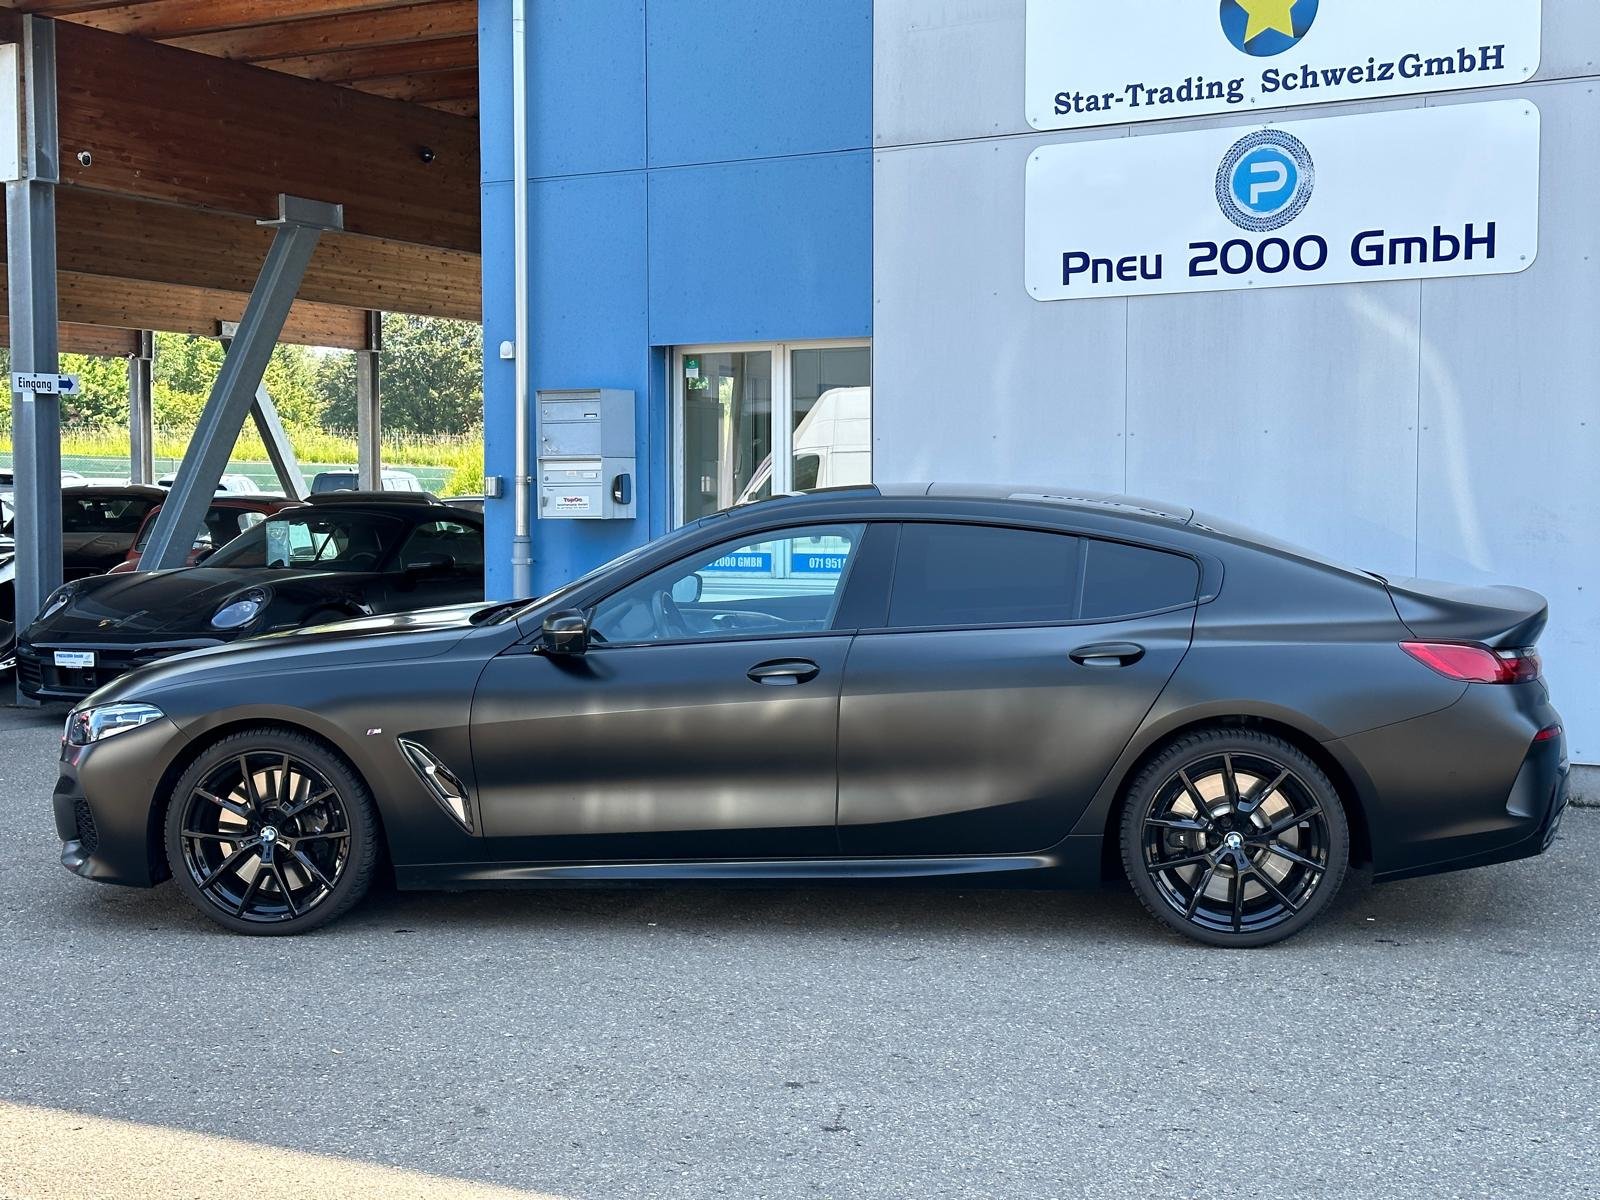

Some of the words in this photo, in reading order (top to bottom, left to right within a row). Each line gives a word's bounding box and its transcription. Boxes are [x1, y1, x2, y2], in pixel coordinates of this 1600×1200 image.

[1053, 75, 1245, 115] Star-Trading
[1061, 249, 1163, 286] Pneu
[1187, 234, 1328, 278] 2000
[1350, 221, 1497, 268] GmbH
[17, 376, 52, 392] Eingang
[714, 556, 736, 568] 2000
[808, 557, 824, 569] 071
[825, 557, 841, 569] 951
